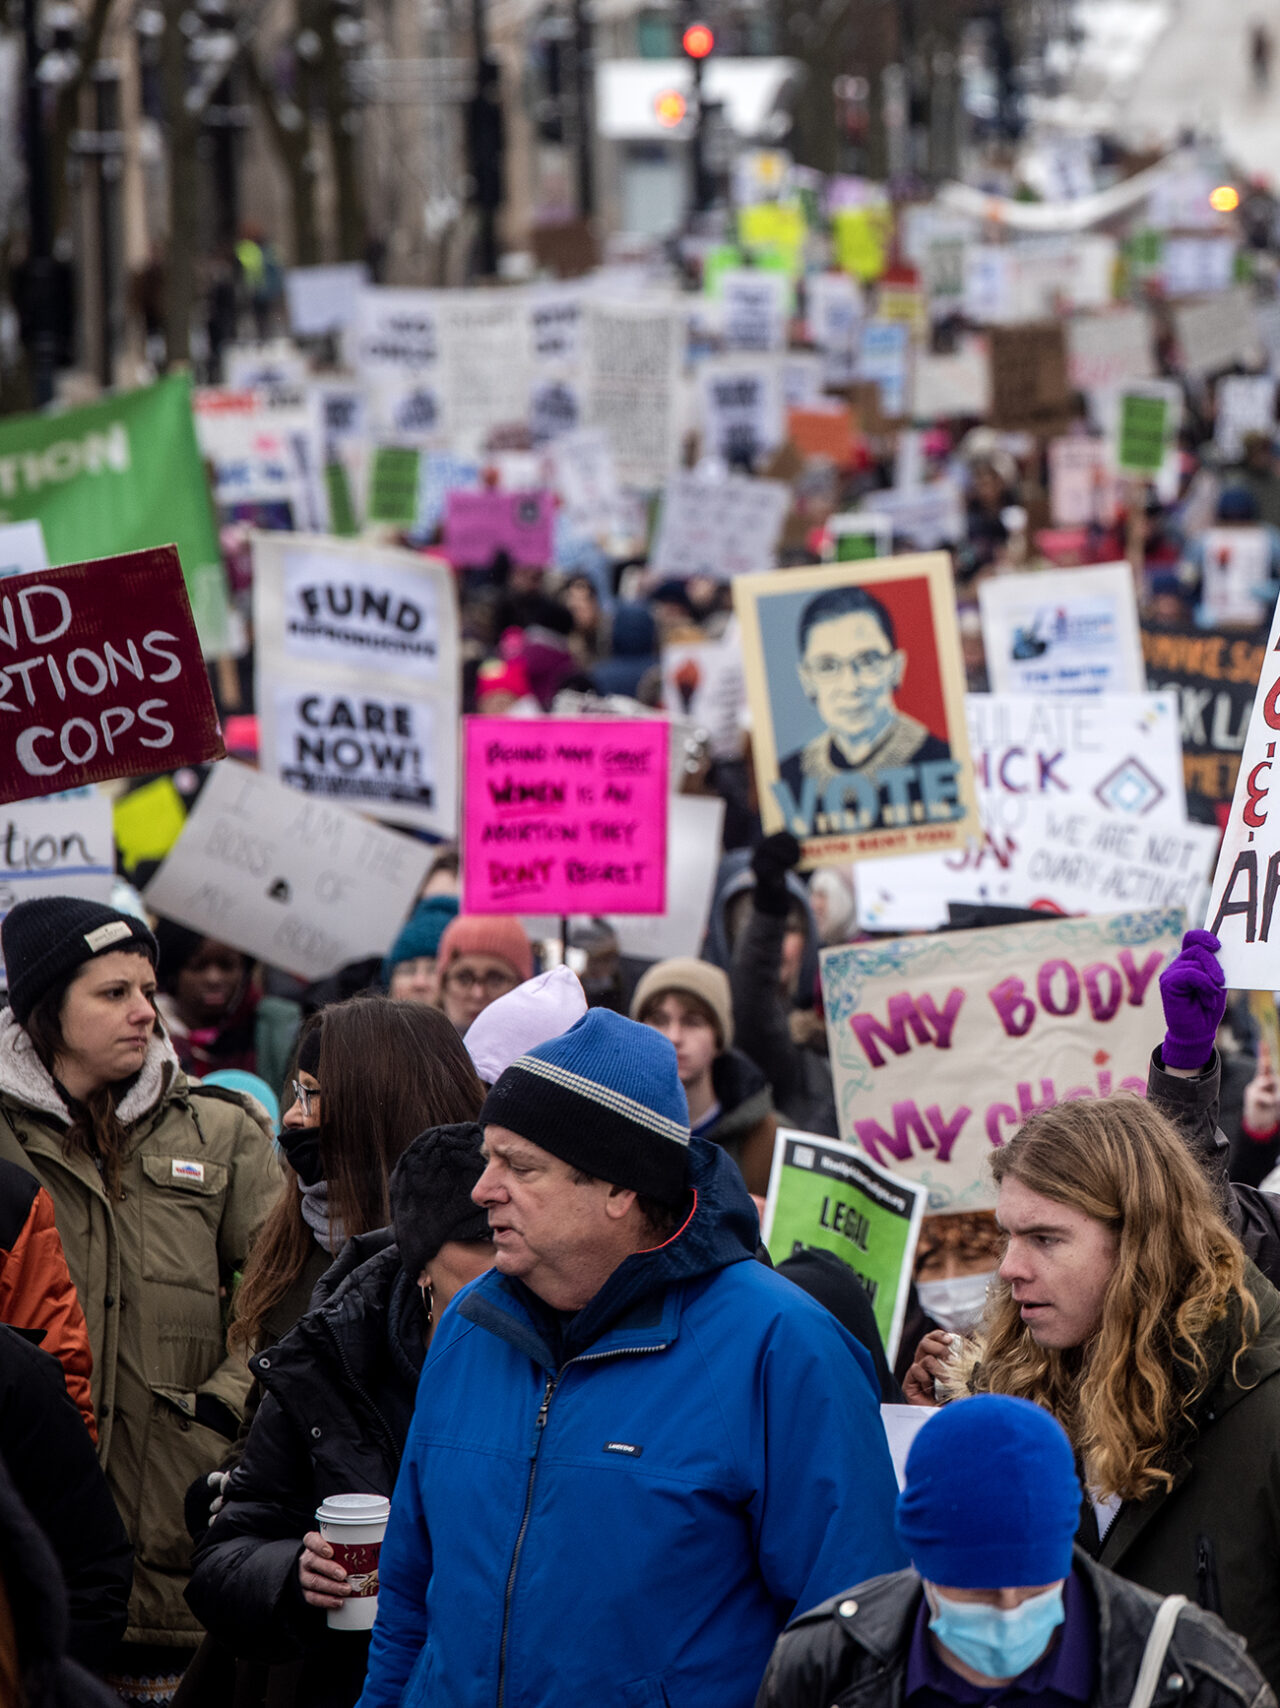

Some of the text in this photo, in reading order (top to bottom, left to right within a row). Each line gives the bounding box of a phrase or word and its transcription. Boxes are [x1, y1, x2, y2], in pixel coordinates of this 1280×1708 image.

[300, 583, 422, 634] FUND
[16, 698, 174, 776] COPS
[299, 695, 411, 738] CARE
[296, 733, 421, 781] NOW!
[975, 747, 1070, 793] ICK
[772, 759, 967, 839] VOTE
[1243, 742, 1276, 843] &
[850, 947, 1165, 1068] MY BODY
[854, 1099, 972, 1169] MY
